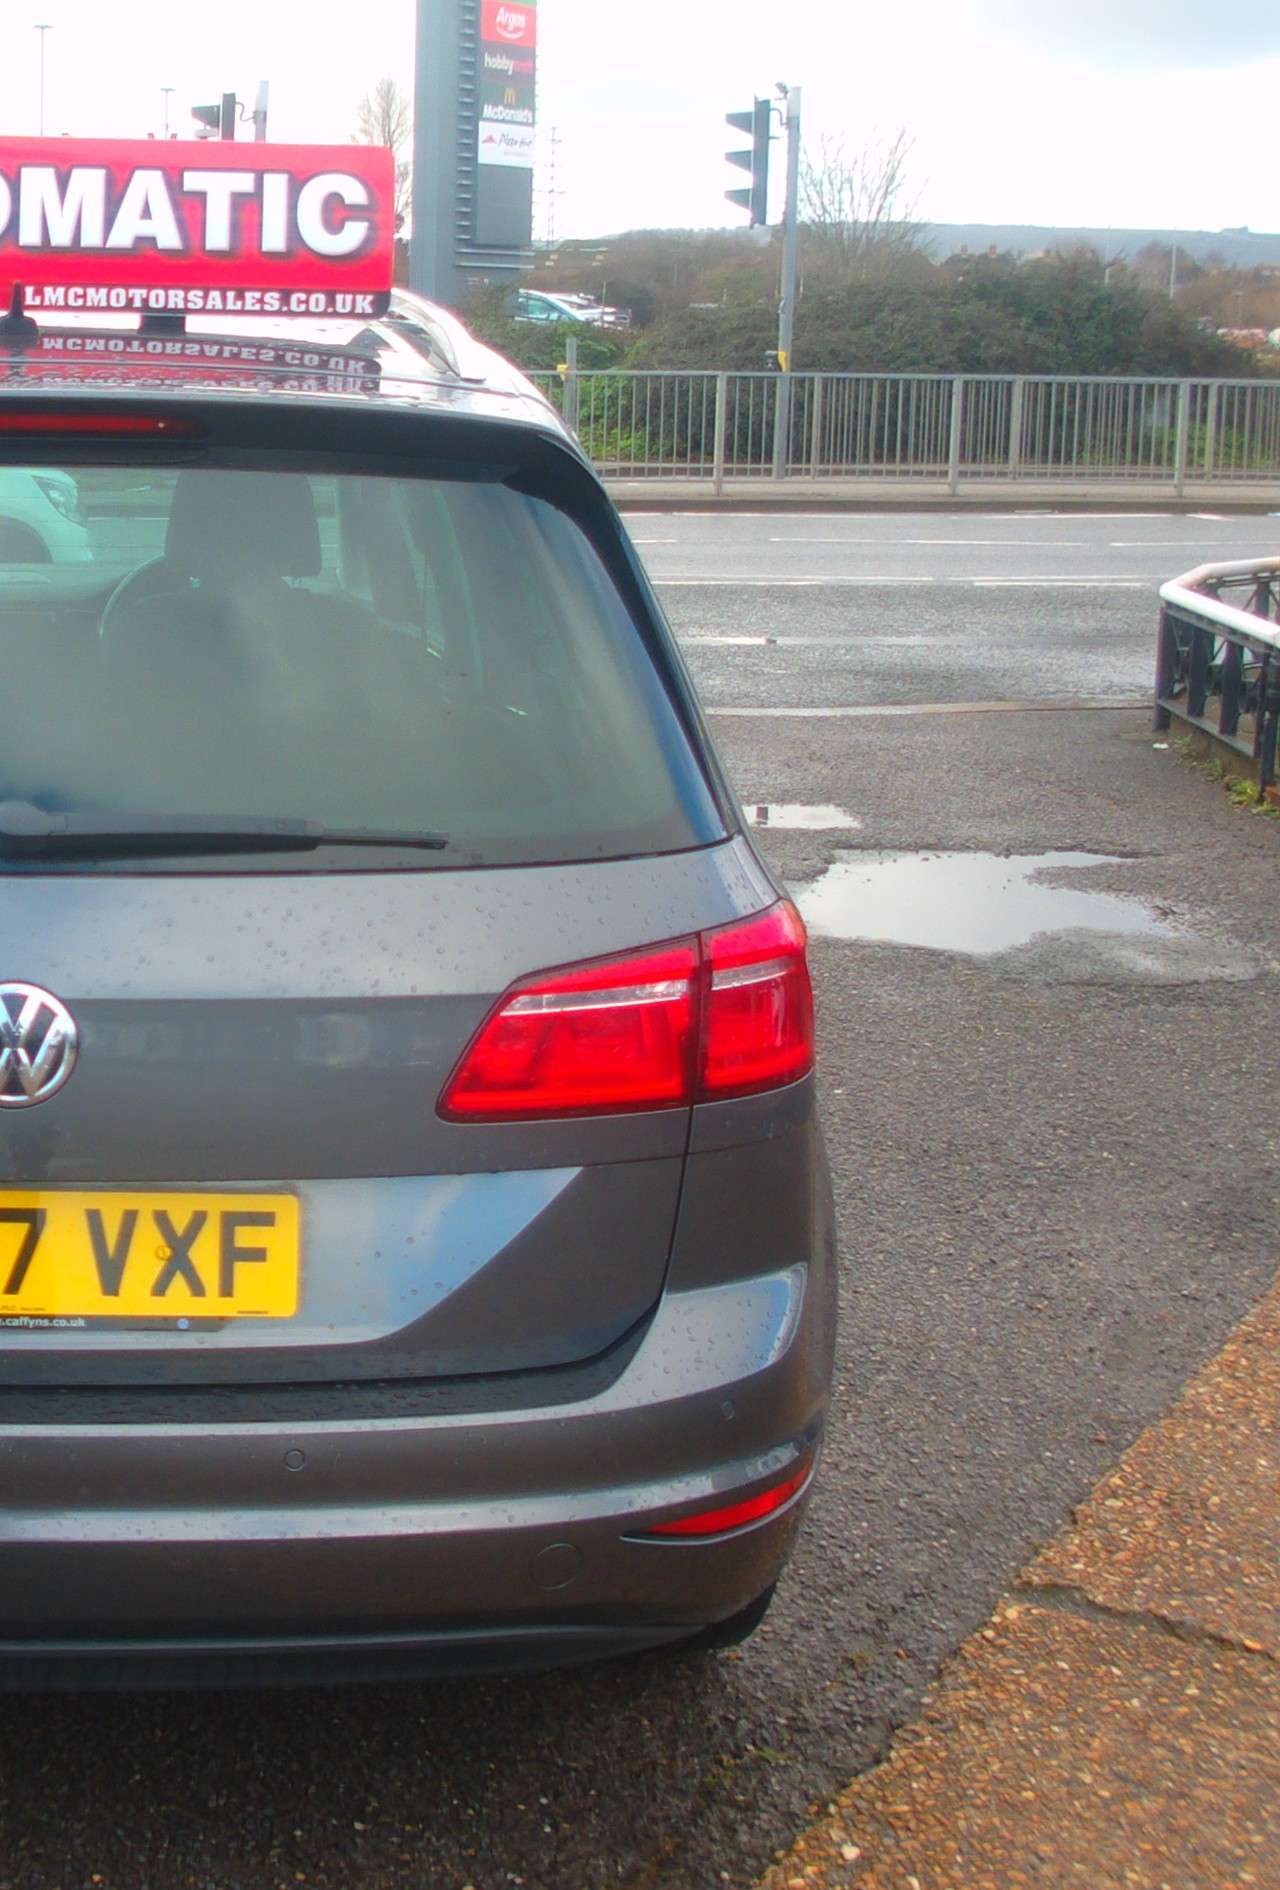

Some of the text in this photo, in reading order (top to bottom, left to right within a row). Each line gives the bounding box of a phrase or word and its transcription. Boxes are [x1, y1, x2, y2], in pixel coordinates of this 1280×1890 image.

[496, 6, 526, 32] Argos
[23, 286, 374, 314] LMCMOTORSALES.CO.UK
[84, 1207, 276, 1298] VXF
